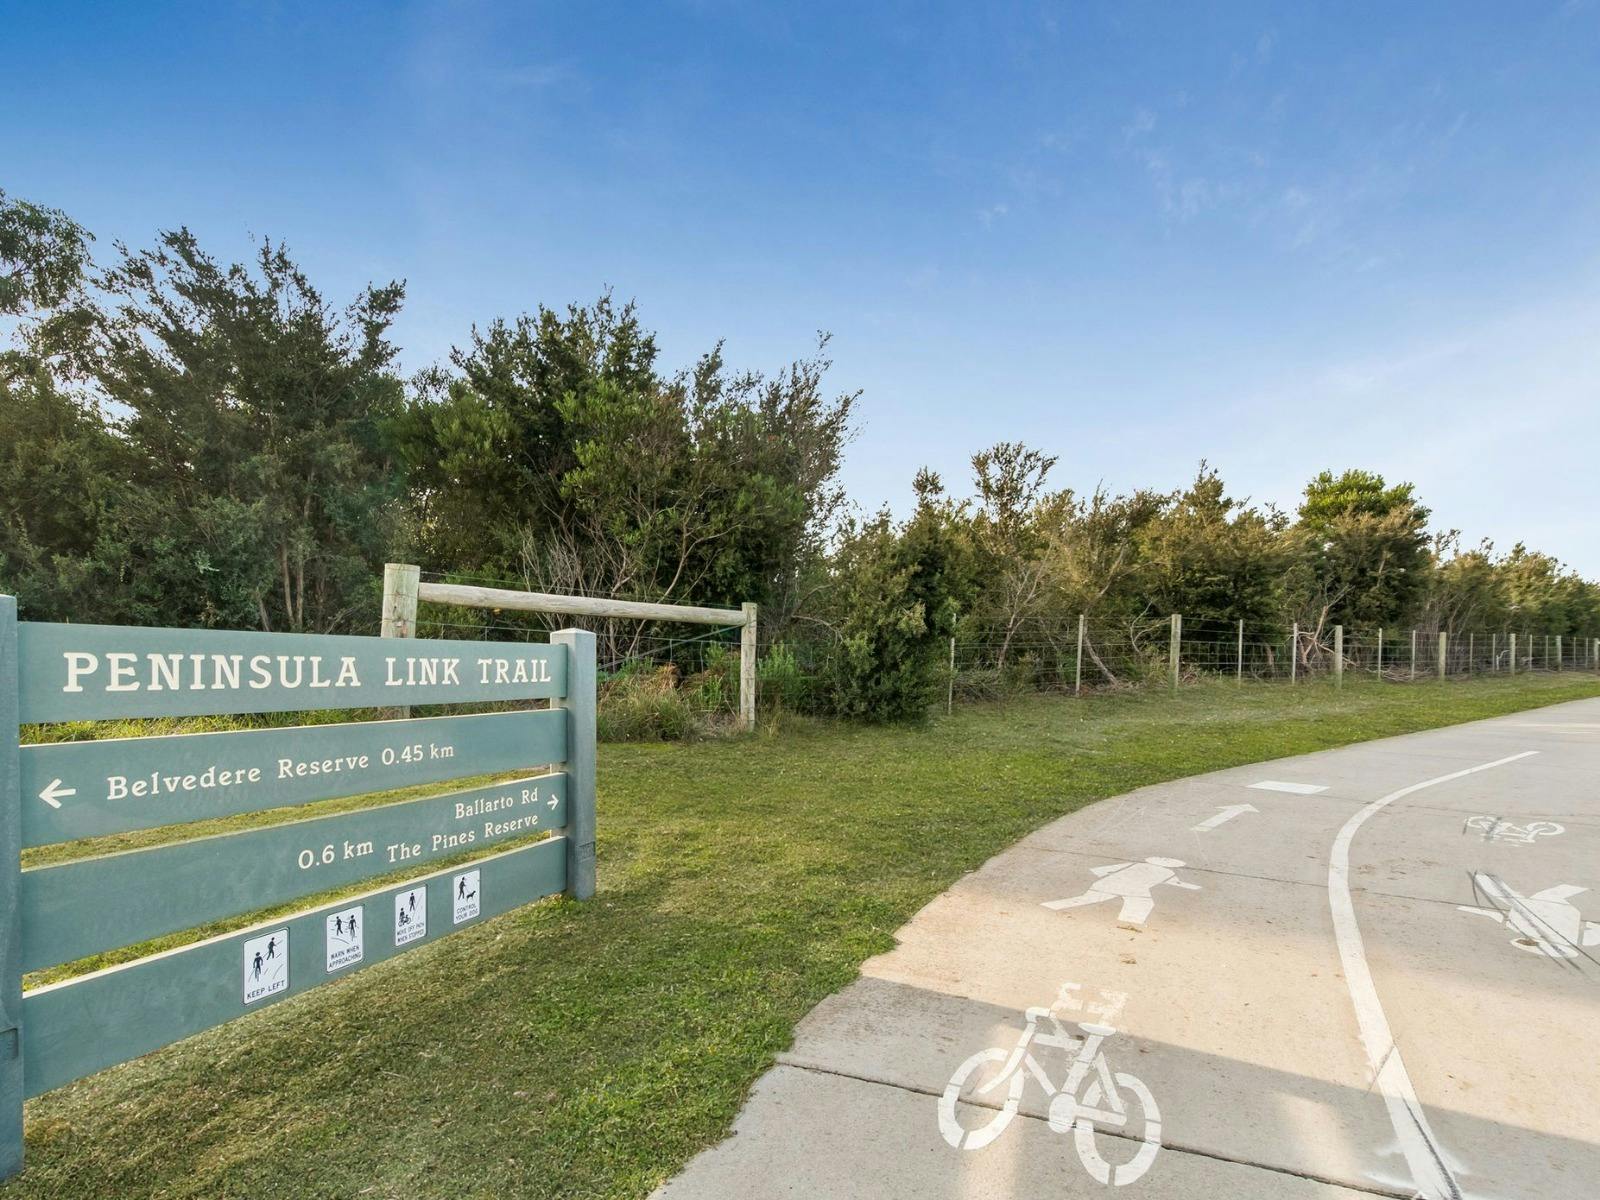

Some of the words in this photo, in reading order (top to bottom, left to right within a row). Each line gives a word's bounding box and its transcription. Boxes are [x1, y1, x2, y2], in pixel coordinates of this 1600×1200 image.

[62, 652, 361, 692] PENINSULA
[384, 656, 460, 687] LINK
[477, 658, 551, 684] TRAIL
[106, 766, 261, 800] Belvedere
[277, 752, 369, 780] Reserve
[381, 744, 424, 766] 0.45
[430, 743, 454, 760] km
[455, 796, 514, 819] Ballarto
[521, 787, 538, 805] Rd
[297, 844, 336, 870] 0.6
[343, 839, 374, 861] km
[386, 844, 422, 864] The
[432, 829, 476, 852] Pines
[484, 814, 539, 839] Reserve
[457, 903, 476, 914] CONTROL
[329, 952, 361, 968] APPROACHING
[331, 951, 345, 960] WARN
[347, 945, 359, 954] WHEN
[247, 987, 265, 999] KEEP
[268, 980, 285, 992] LEFT
